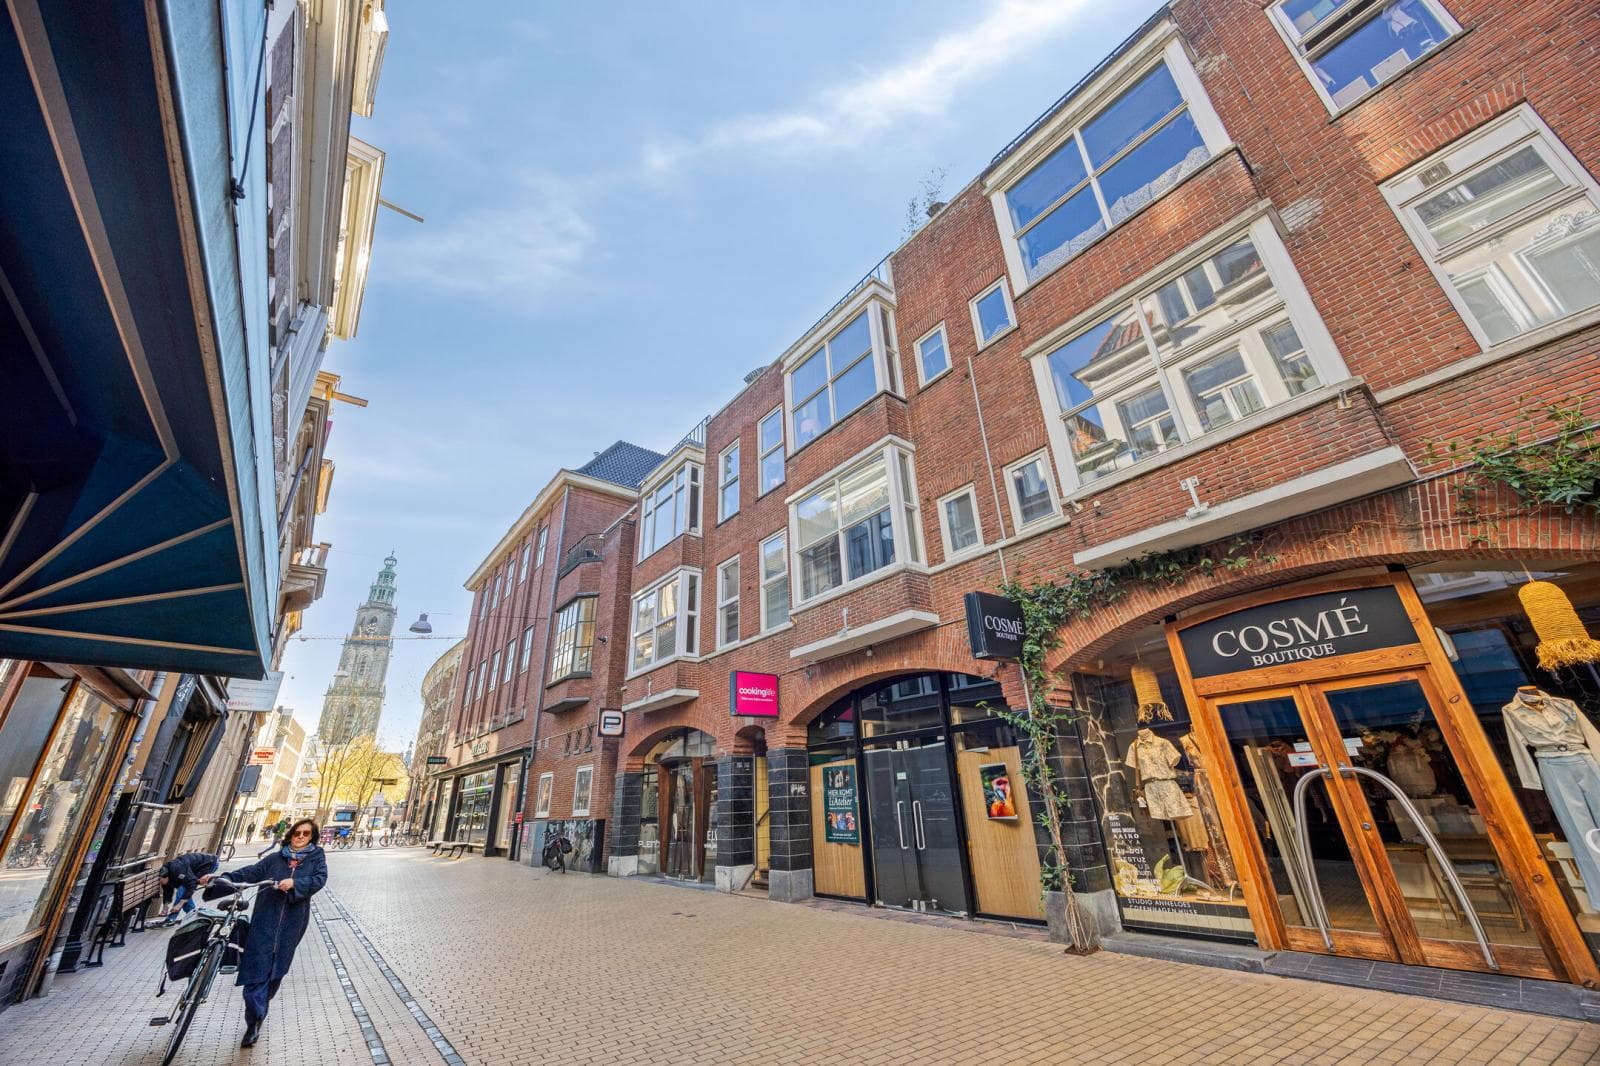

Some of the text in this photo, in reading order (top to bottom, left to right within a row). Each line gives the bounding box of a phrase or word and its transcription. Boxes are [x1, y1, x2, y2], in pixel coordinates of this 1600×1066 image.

[984, 615, 1025, 635] COSMÉ
[1212, 597, 1369, 657] COSMÉ
[1252, 642, 1336, 667] BOUTIQUE
[1127, 898, 1191, 908] STUDIO ANNELOES
